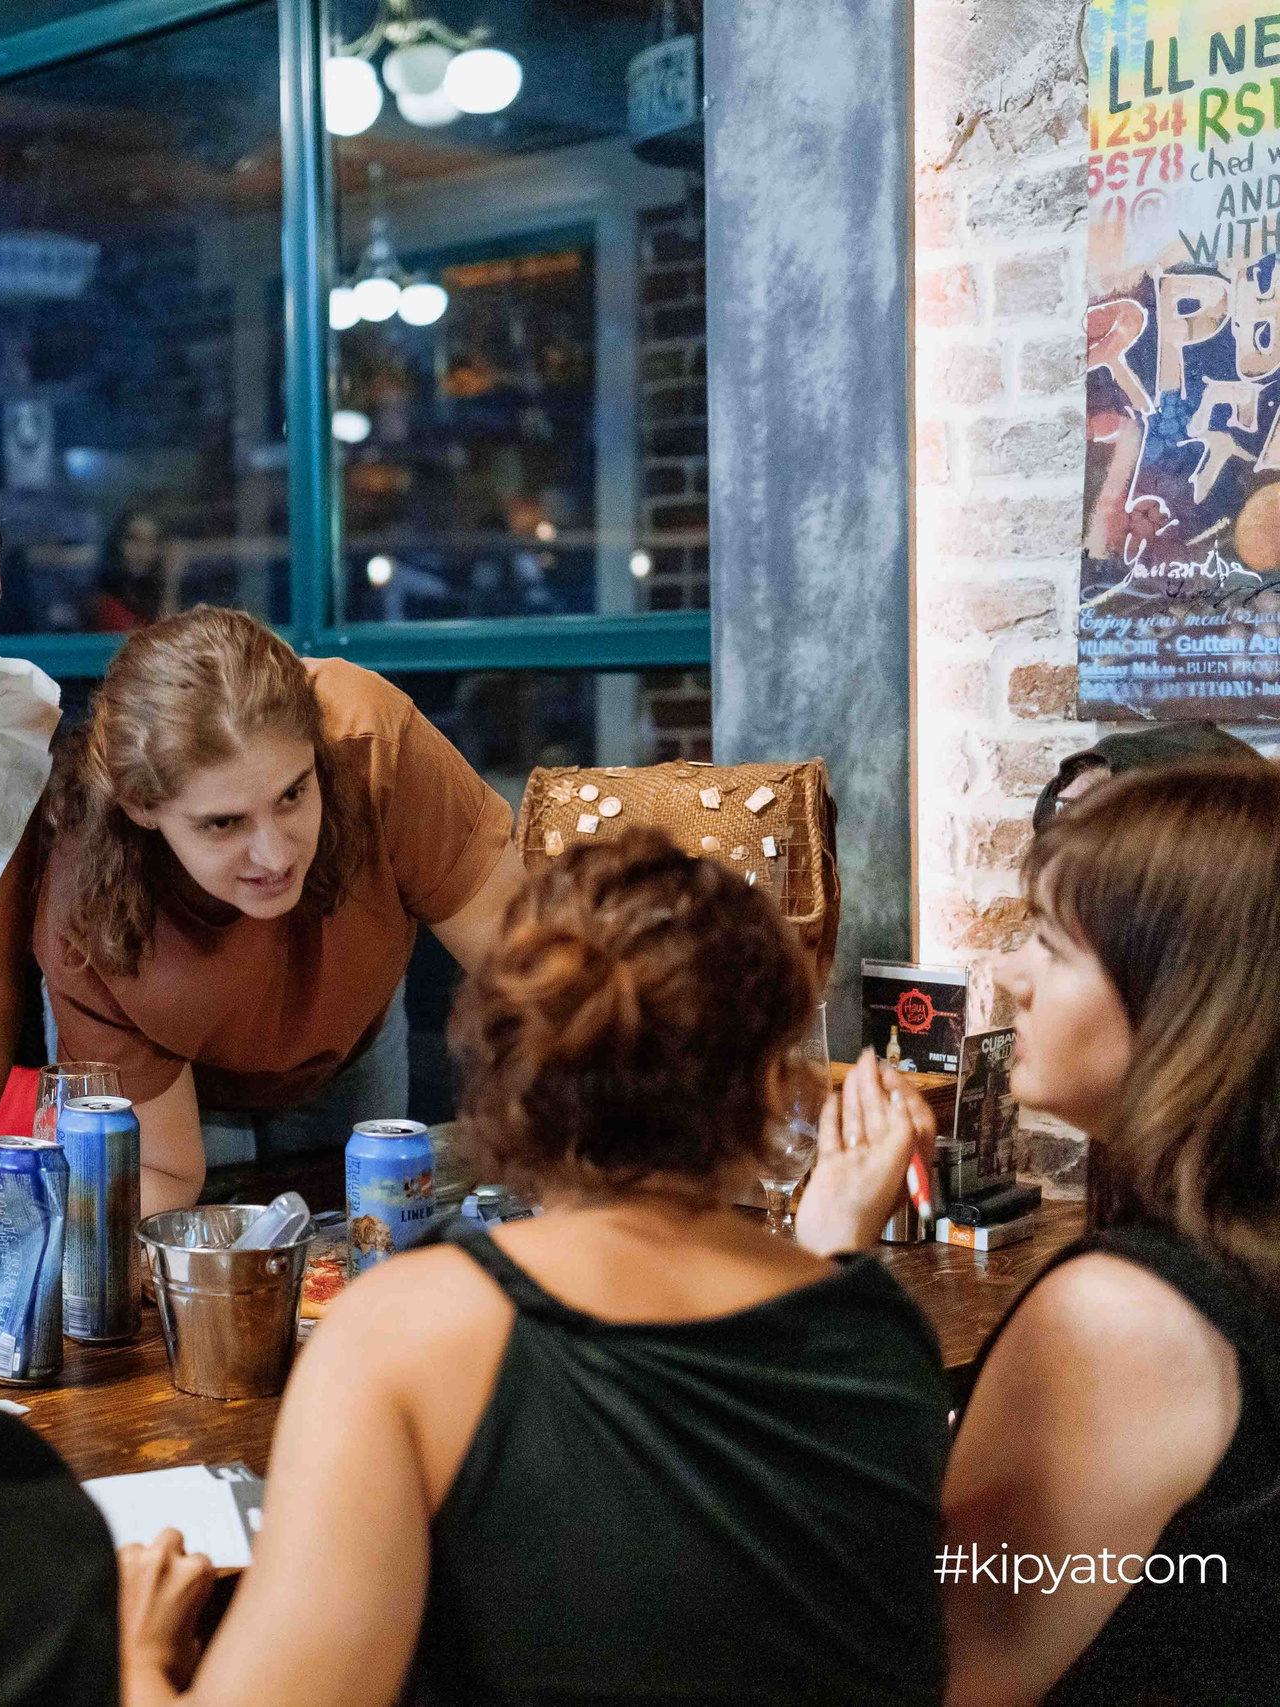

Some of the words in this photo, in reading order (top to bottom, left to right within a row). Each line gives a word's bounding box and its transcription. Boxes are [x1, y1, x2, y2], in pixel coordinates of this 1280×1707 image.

[1088, 142, 1184, 198] 5678
[1216, 174, 1280, 219] AND
[1178, 211, 1280, 264] WITH
[1080, 608, 1133, 638] Enjoy
[1175, 634, 1245, 653] Gutten
[1249, 633, 1280, 655] Ap
[1187, 661, 1228, 674] BUEN
[952, 1230, 970, 1242] neo
